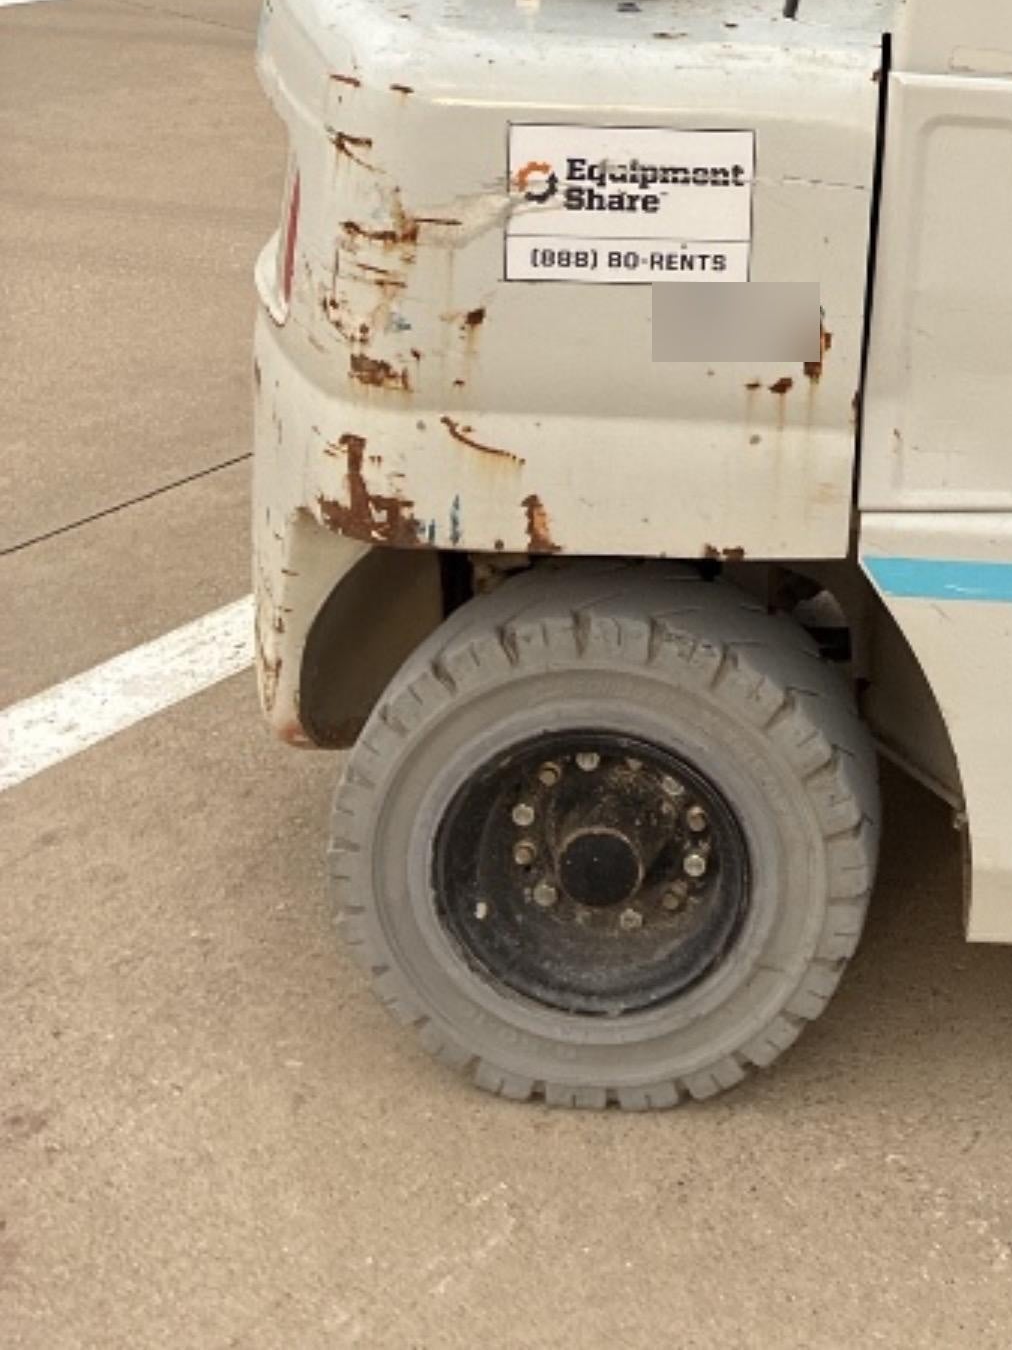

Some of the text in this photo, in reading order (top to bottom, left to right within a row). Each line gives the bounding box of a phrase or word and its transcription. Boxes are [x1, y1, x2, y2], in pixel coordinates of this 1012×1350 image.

[566, 158, 746, 189] Equipment
[563, 186, 661, 213] Share
[530, 248, 598, 270] (888)
